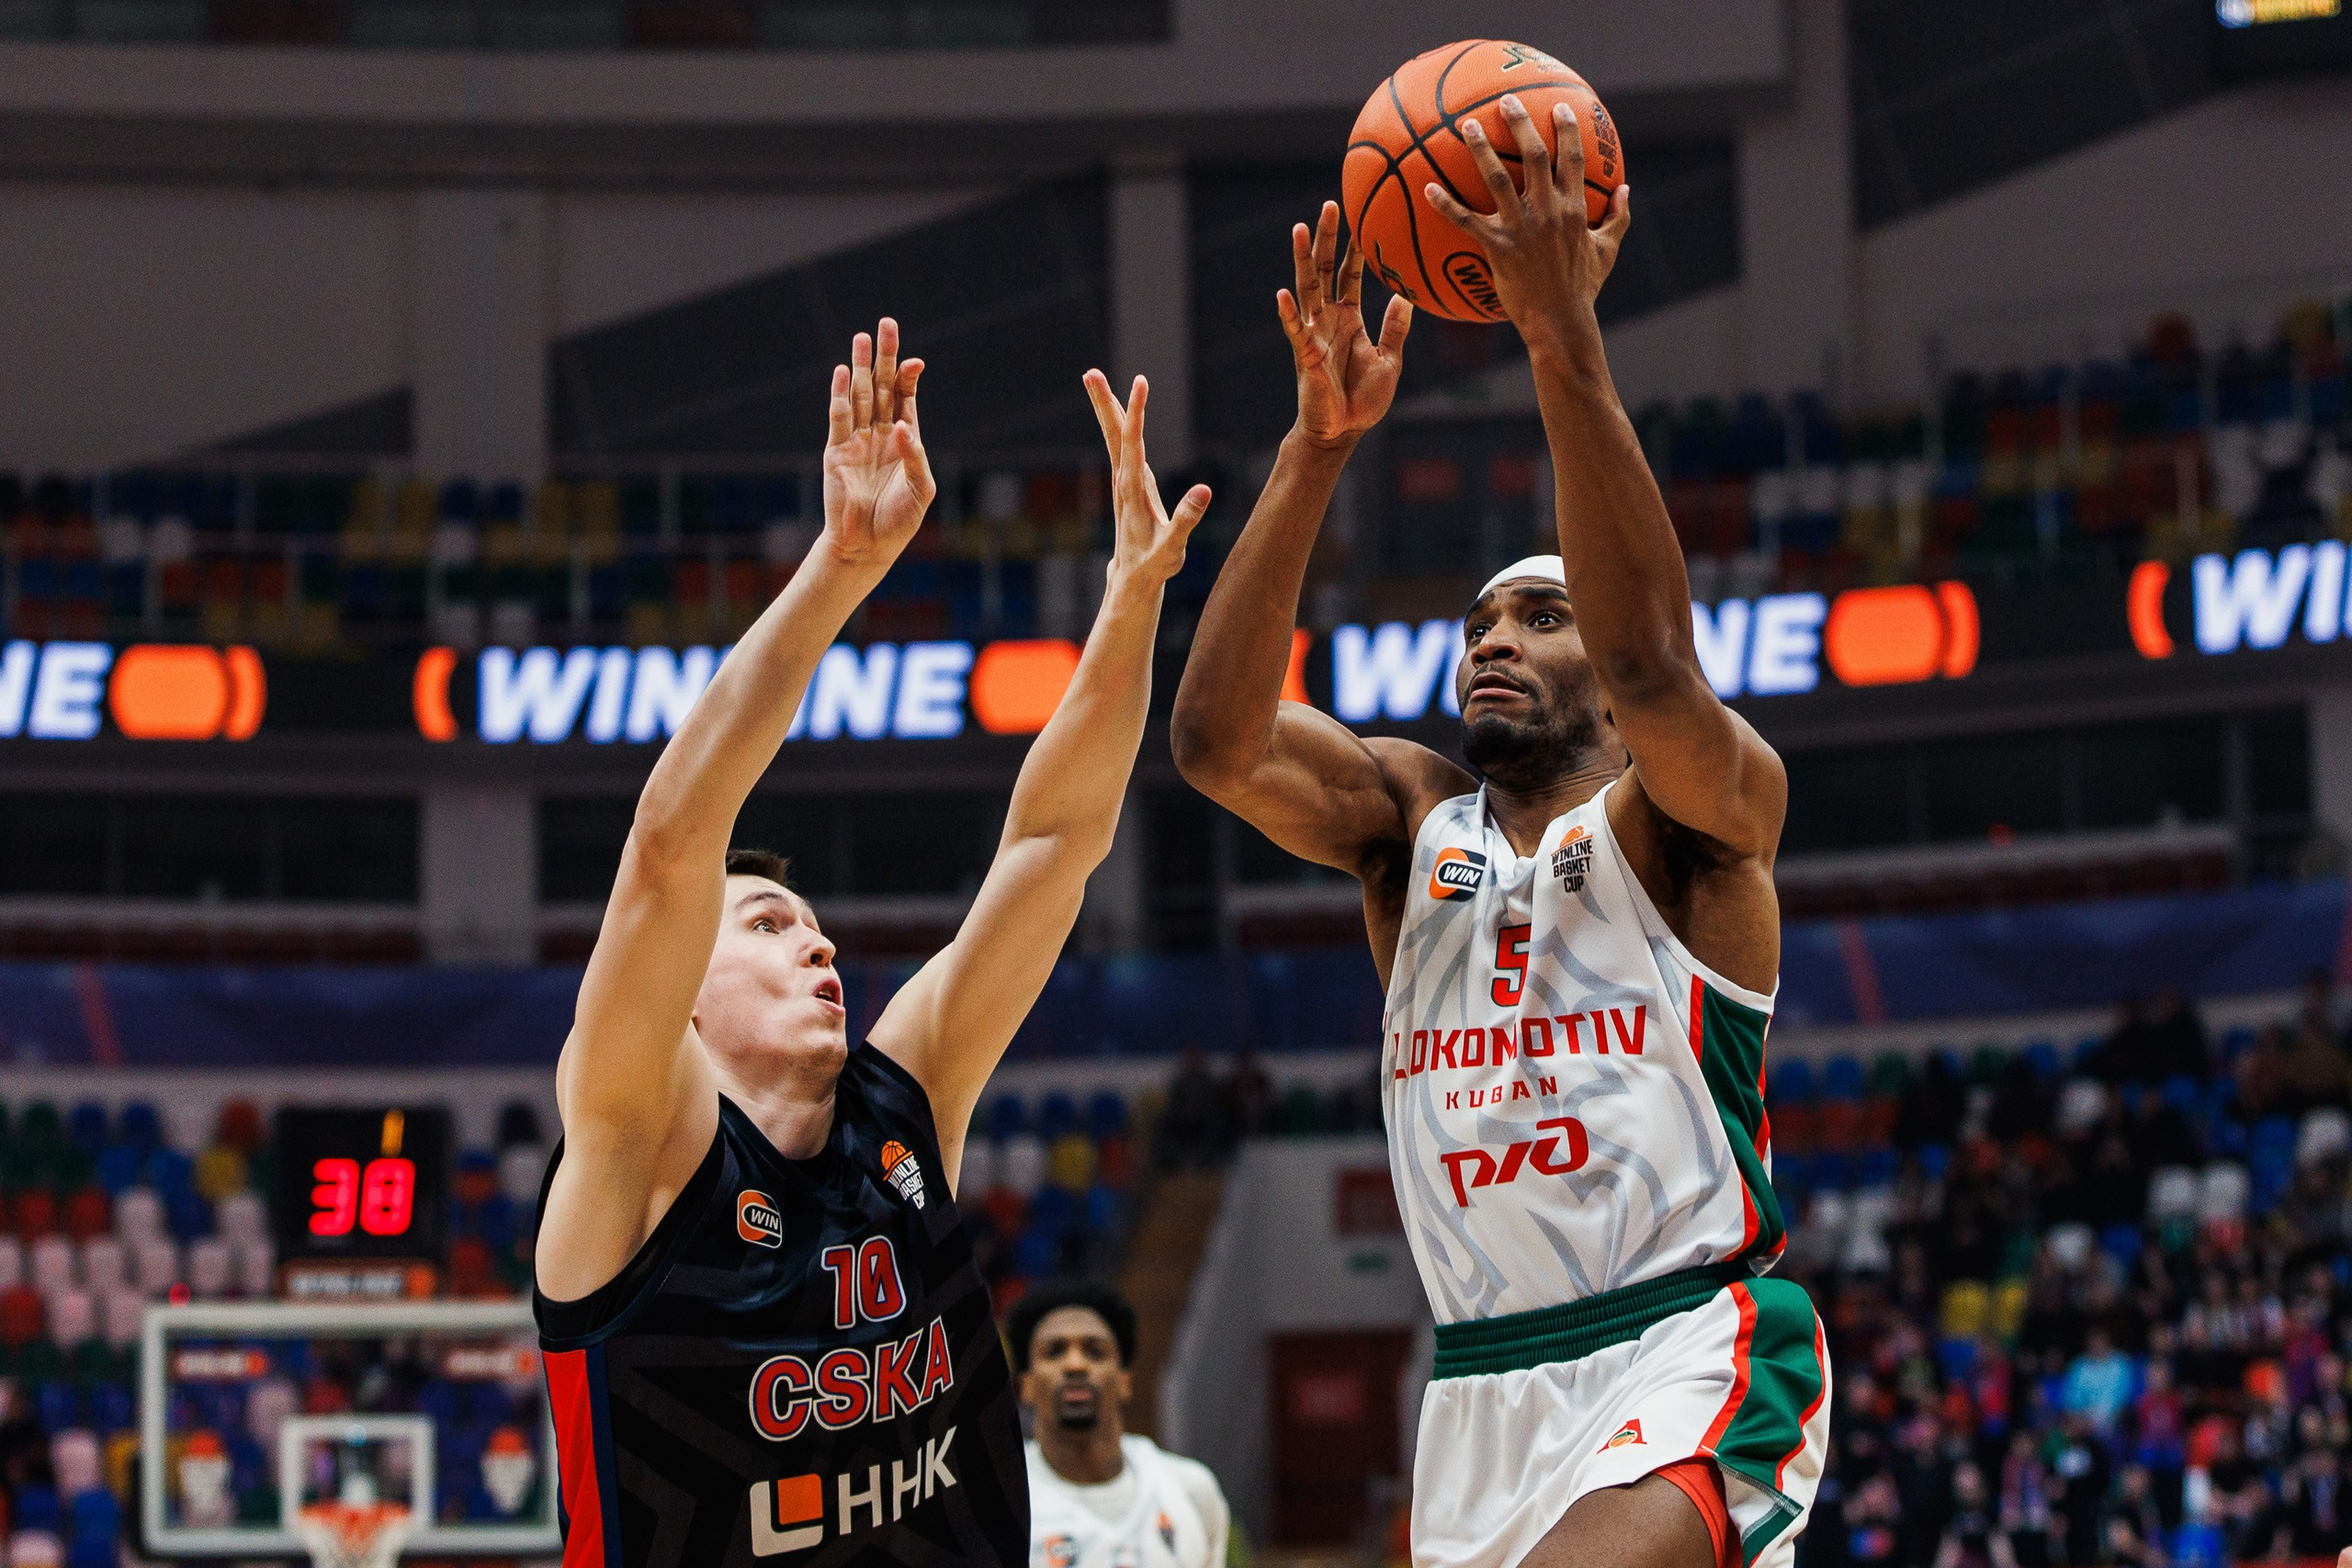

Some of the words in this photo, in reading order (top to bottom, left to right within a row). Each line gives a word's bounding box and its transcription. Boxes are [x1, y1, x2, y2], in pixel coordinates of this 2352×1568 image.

[2191, 539, 2352, 654] WI
[477, 641, 975, 745] WINNE
[1442, 864, 1481, 886] WIN
[1551, 840, 1594, 865] WINLINE
[1553, 857, 1591, 878] BASKET
[1564, 875, 1585, 893] CUP
[1490, 923, 1532, 1007] 5
[1394, 1005, 1647, 1080] LOKOMOTIV
[1445, 1076, 1558, 1110] KUBAN
[308, 1157, 416, 1236] 38
[751, 1208, 779, 1230] WIN
[821, 1235, 907, 1329] 10
[749, 1314, 955, 1442] CSKA
